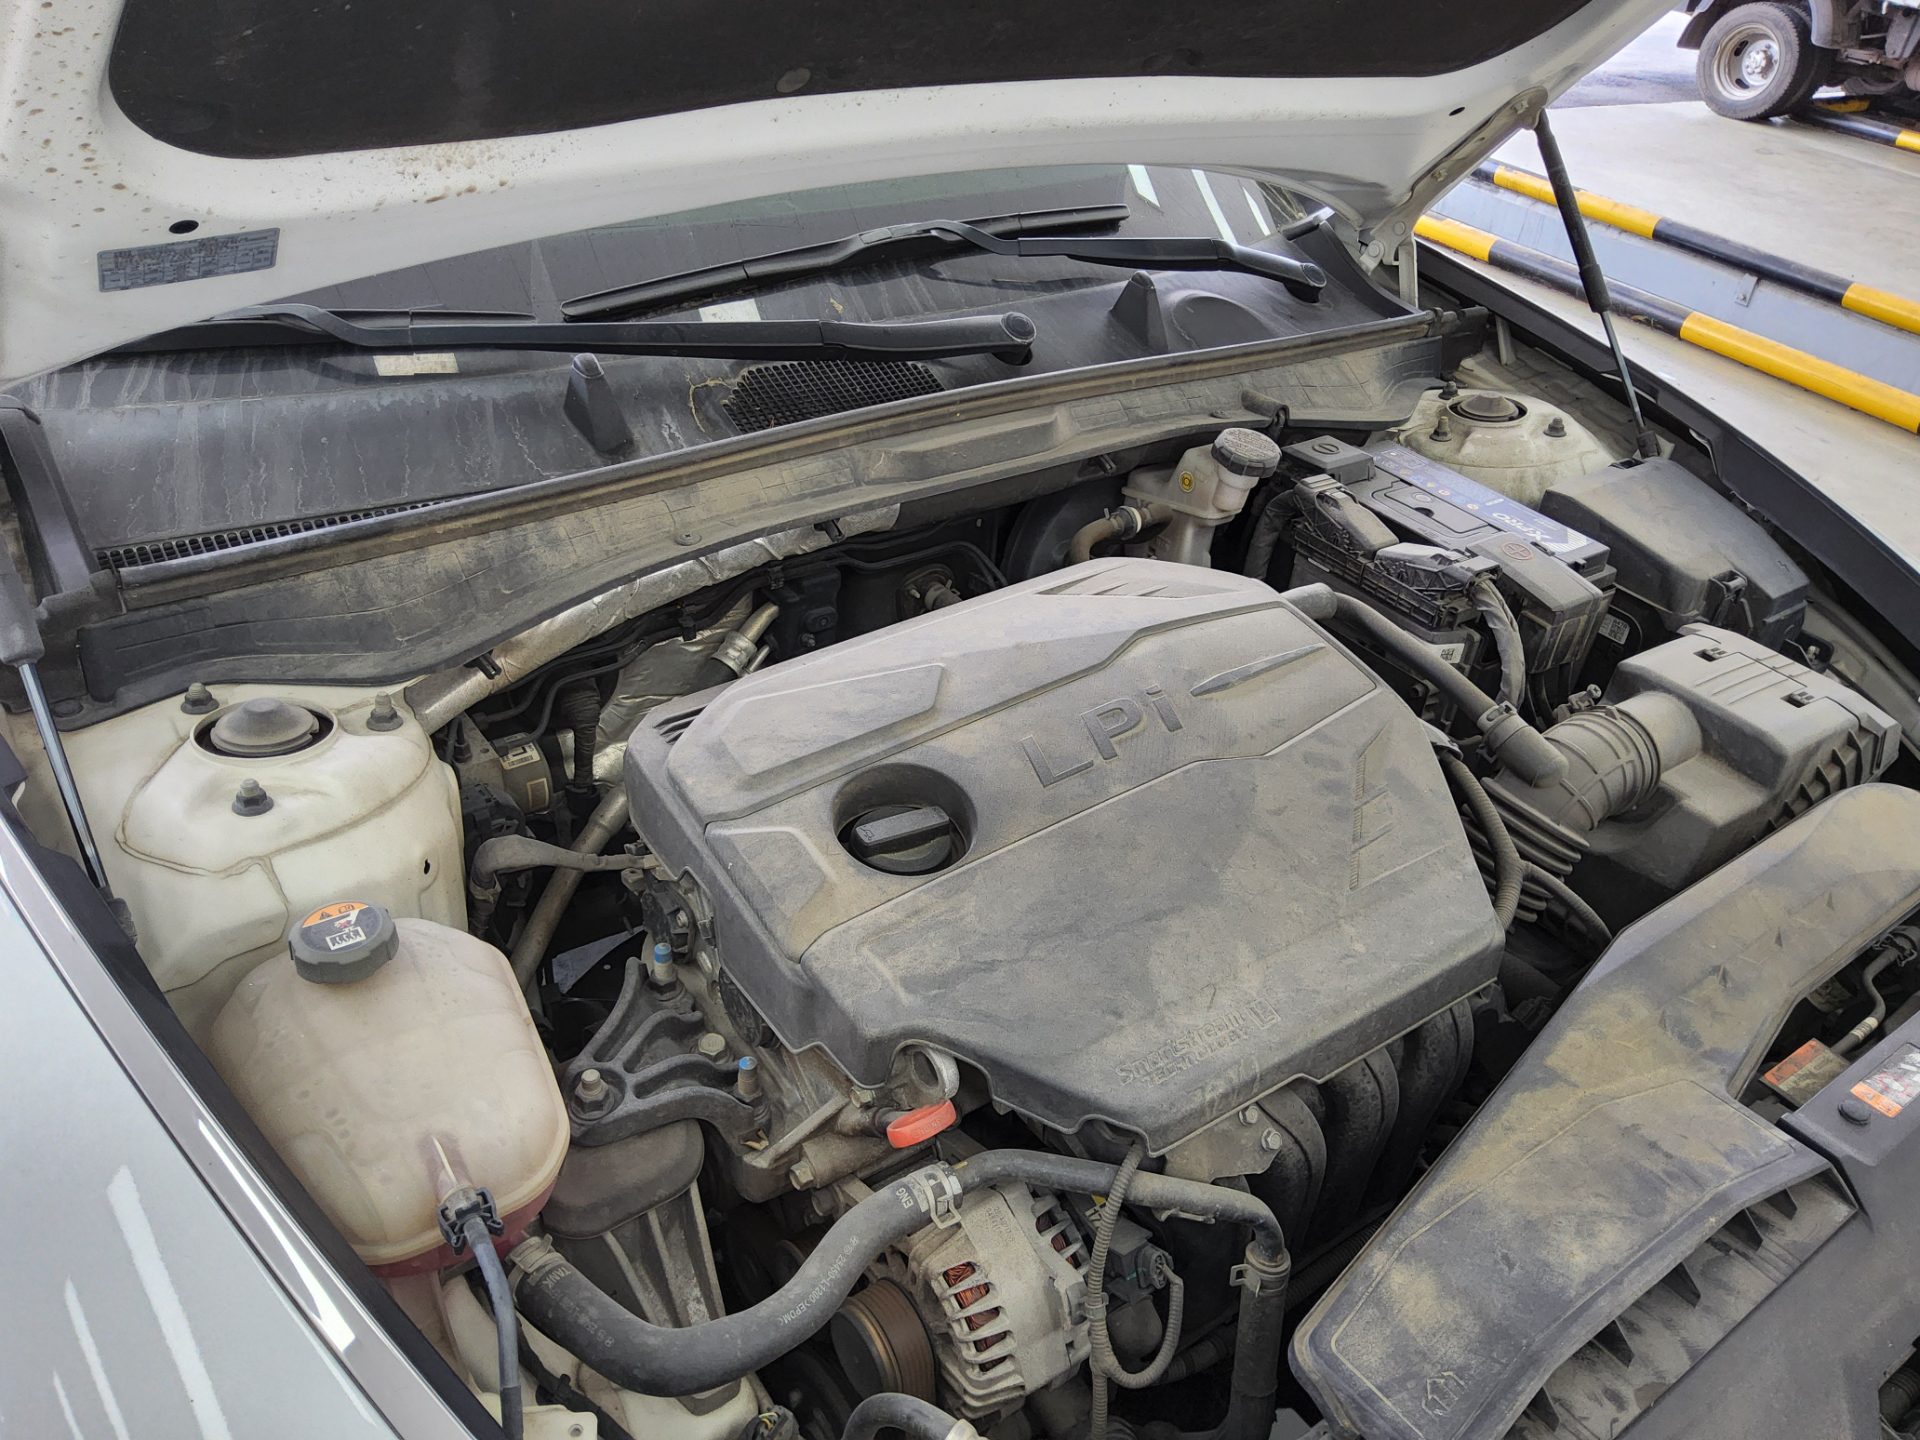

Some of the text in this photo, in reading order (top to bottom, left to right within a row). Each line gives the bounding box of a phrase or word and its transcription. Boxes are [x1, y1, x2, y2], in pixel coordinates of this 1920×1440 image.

[1017, 683, 1183, 788] LPi
[895, 1187, 914, 1209] ENG
[541, 1266, 572, 1289] TANK
